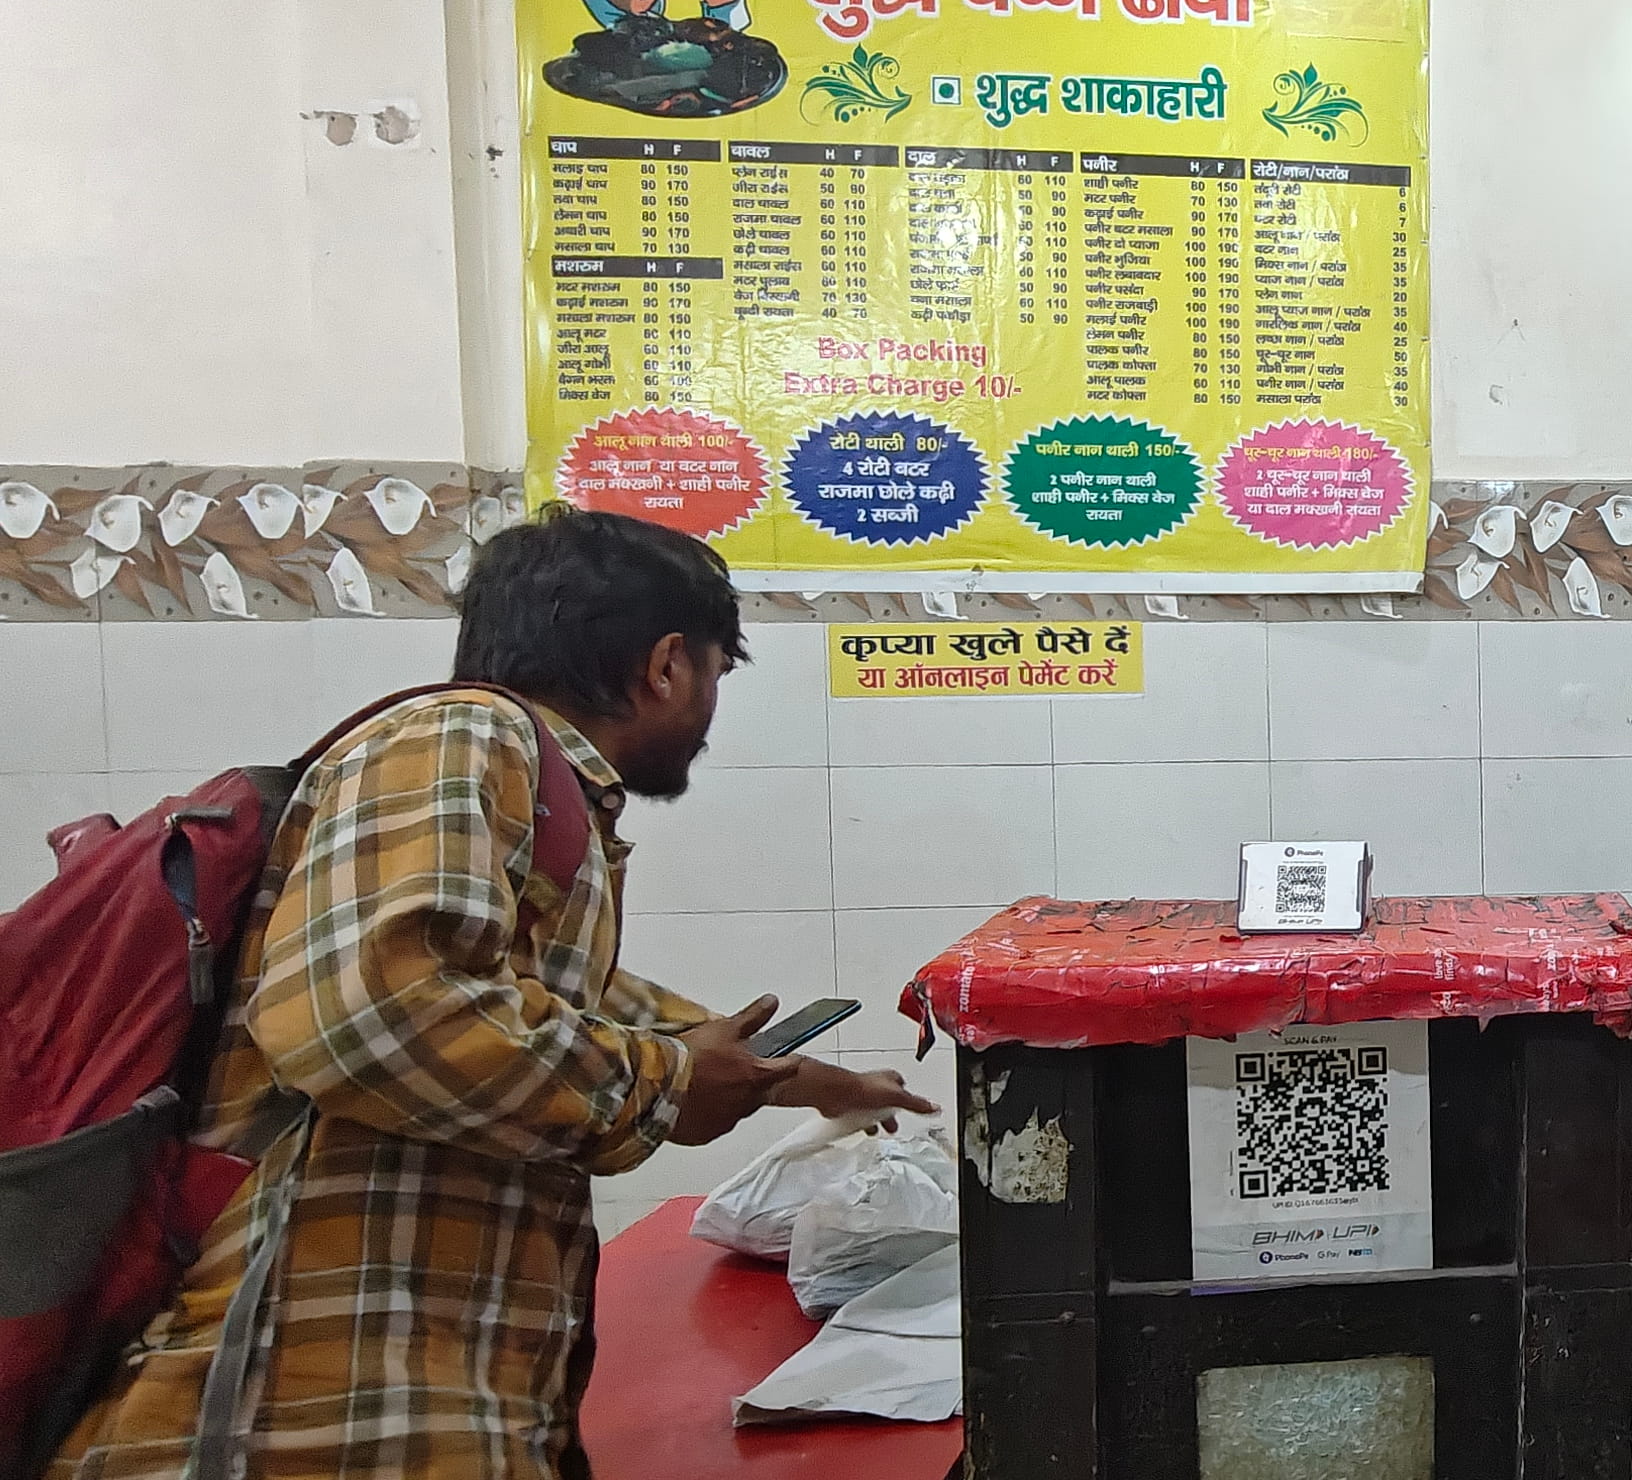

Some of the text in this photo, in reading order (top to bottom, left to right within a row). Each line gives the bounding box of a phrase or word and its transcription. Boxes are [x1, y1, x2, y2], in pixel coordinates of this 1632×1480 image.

[978, 65, 1225, 125] शुद्ध शाकाहारी
[644, 144, 653, 155] H
[674, 144, 682, 155] F
[826, 149, 835, 160] H
[854, 150, 862, 160] F
[1017, 155, 1026, 166] H
[1051, 156, 1059, 166] F
[820, 168, 834, 178] 40
[851, 169, 864, 178] 70
[1190, 162, 1200, 172] H
[1217, 163, 1224, 173] F
[844, 216, 865, 226] 110
[647, 262, 656, 272] H
[676, 263, 683, 272] F
[1186, 303, 1206, 312] 100
[818, 337, 986, 367] Box Packing
[784, 372, 1022, 401] Extra Charge 10/-
[829, 433, 859, 450] रोटी
[842, 462, 853, 475] 4
[857, 458, 890, 475] रोटी
[857, 509, 866, 521] 2
[949, 628, 1023, 660] खुले
[1036, 626, 1092, 654] पैसे
[1105, 626, 1131, 653] दें
[857, 658, 1118, 690] या ऑनलाइन पेमेंट करें
[1252, 1225, 1372, 1245] BHIM UPI
